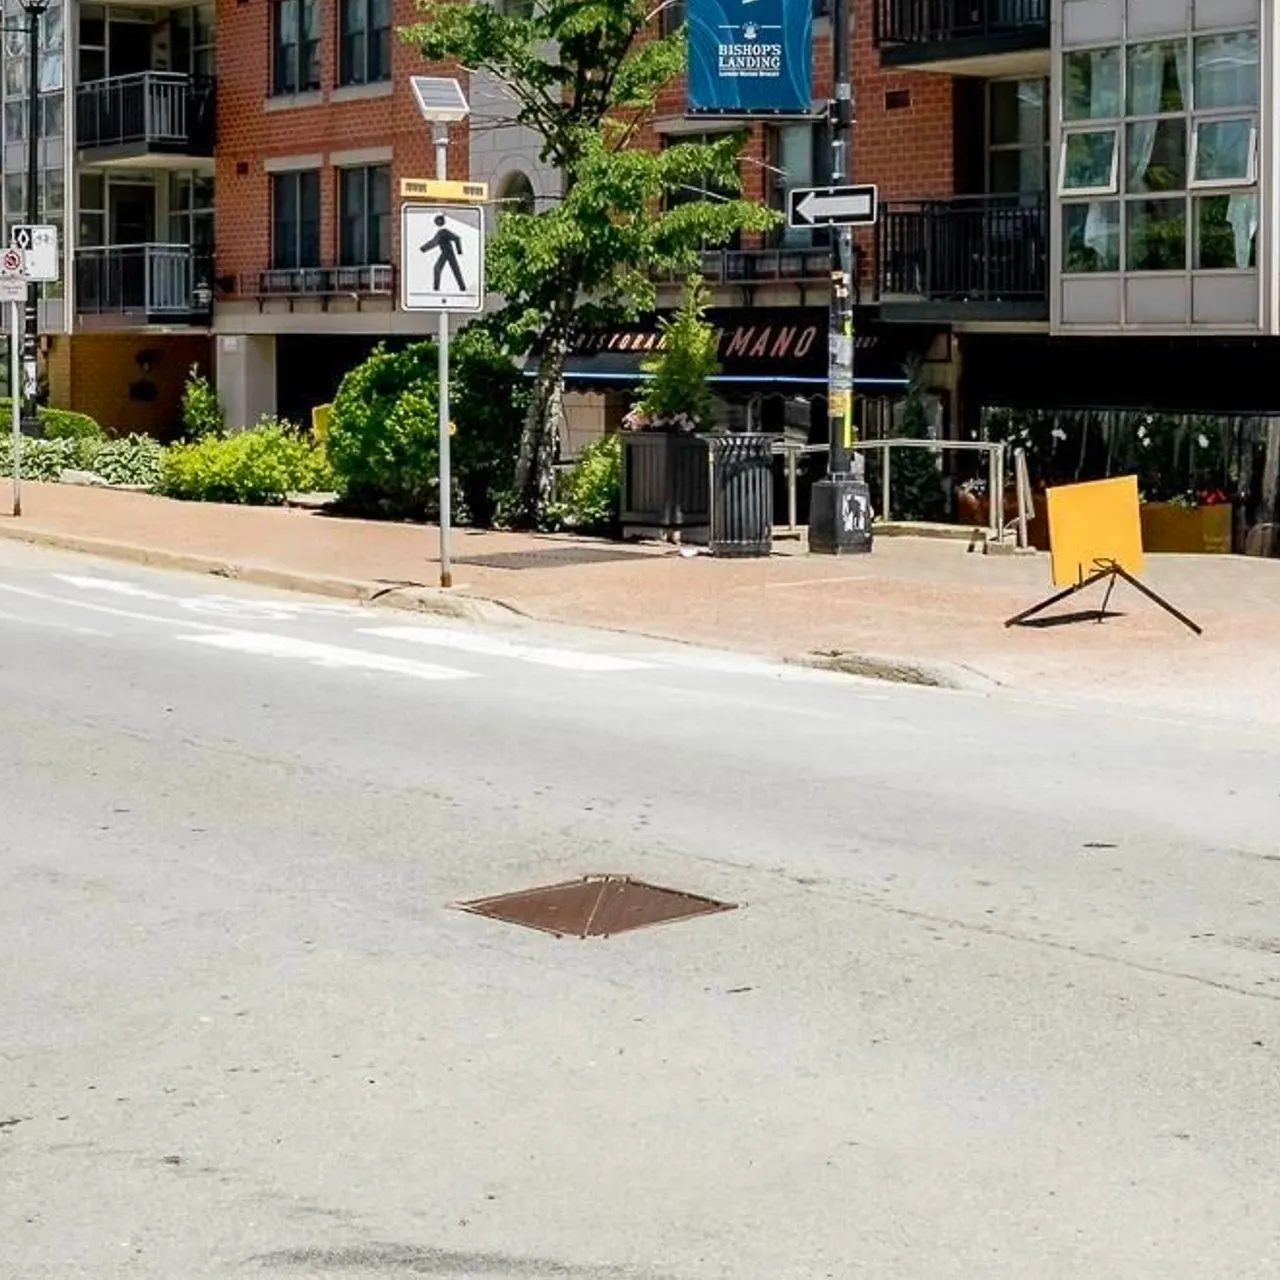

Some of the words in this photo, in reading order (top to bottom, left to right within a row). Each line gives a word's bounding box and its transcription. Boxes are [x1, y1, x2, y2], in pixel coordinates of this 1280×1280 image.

[718, 44, 782, 56] BISHOP'S
[718, 56, 781, 68] LANDING
[724, 325, 818, 358] MANO
